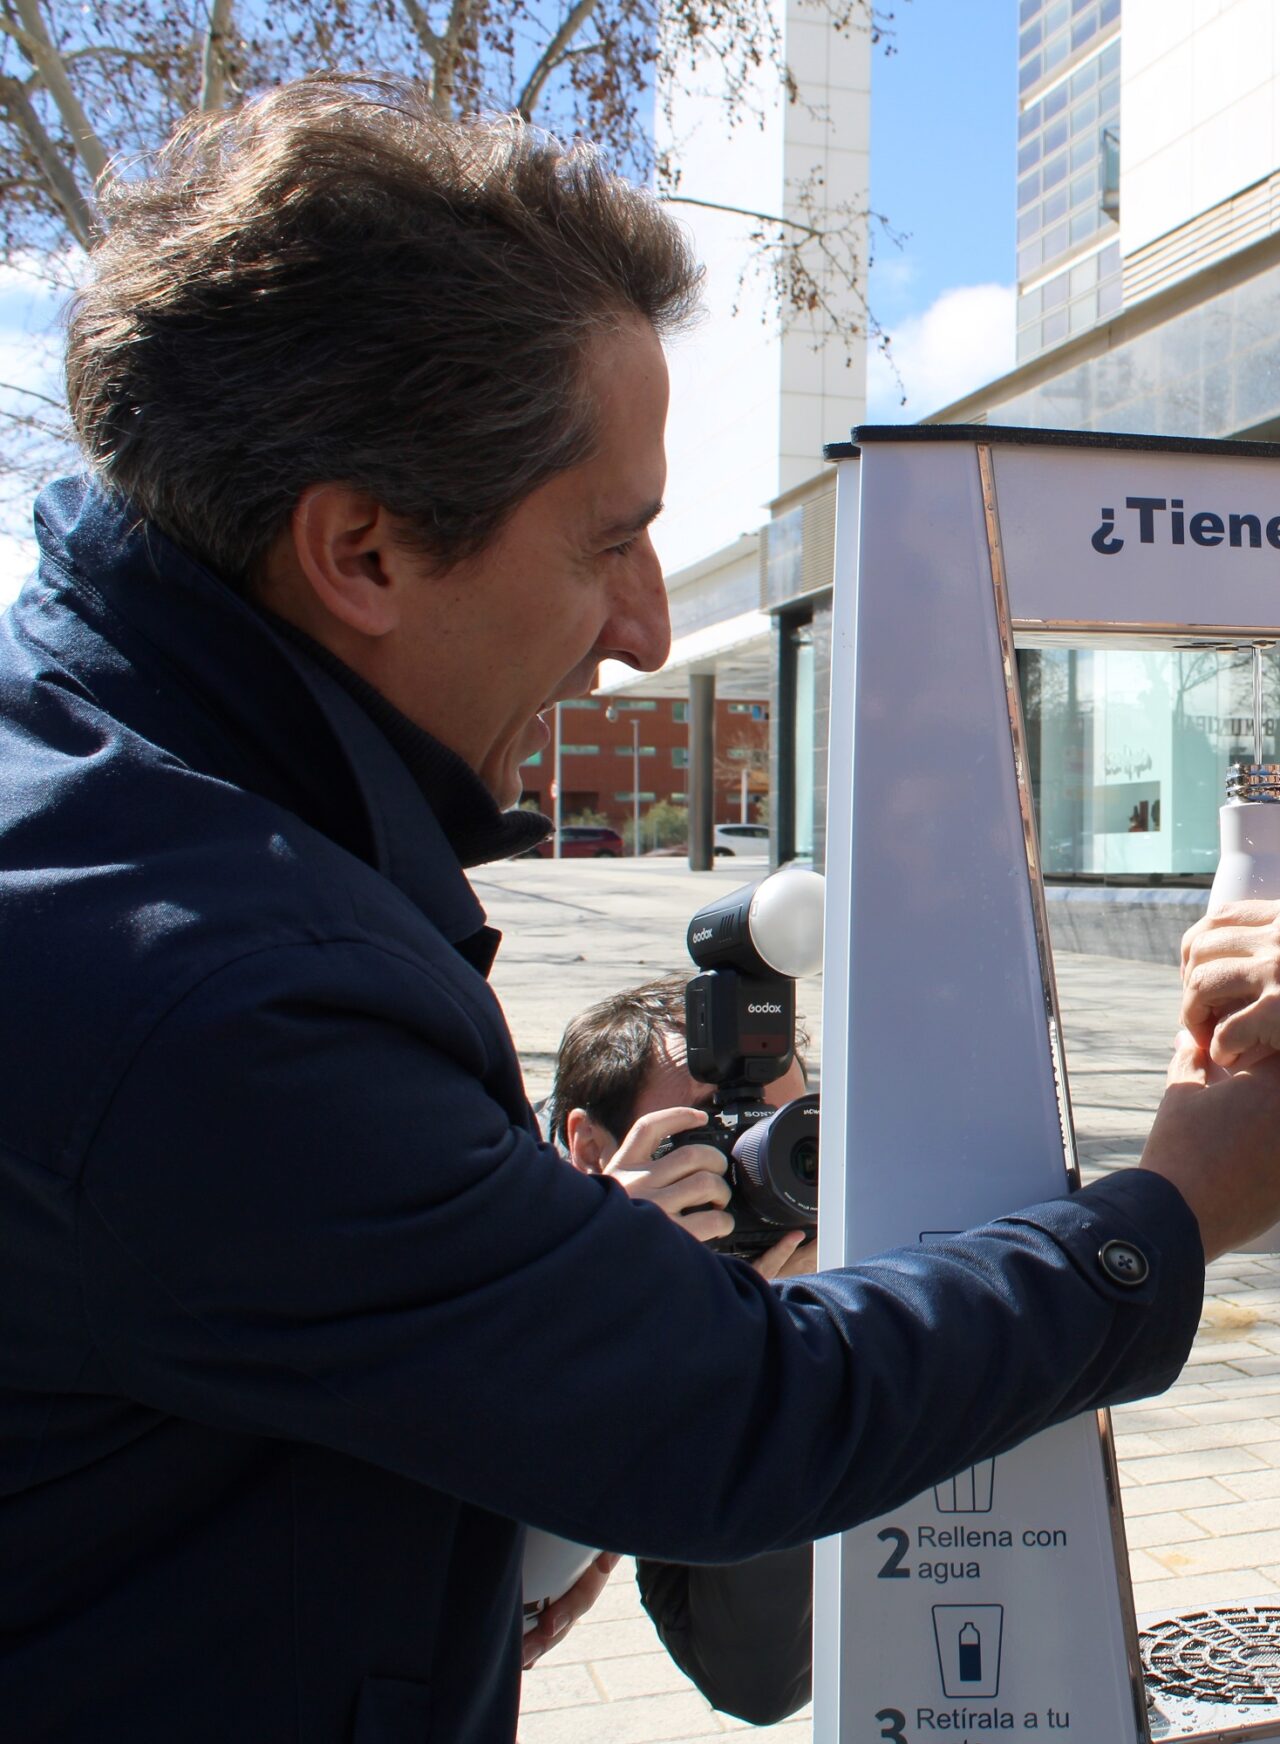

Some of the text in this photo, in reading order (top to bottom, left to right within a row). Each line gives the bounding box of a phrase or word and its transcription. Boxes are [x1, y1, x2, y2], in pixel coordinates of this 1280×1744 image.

[747, 1001, 782, 1014] Godox
[876, 1525, 1067, 1579] 2 Rellena con
[917, 1561, 981, 1584] agua
[874, 1707, 1070, 1744] 3 Retírala a tu
